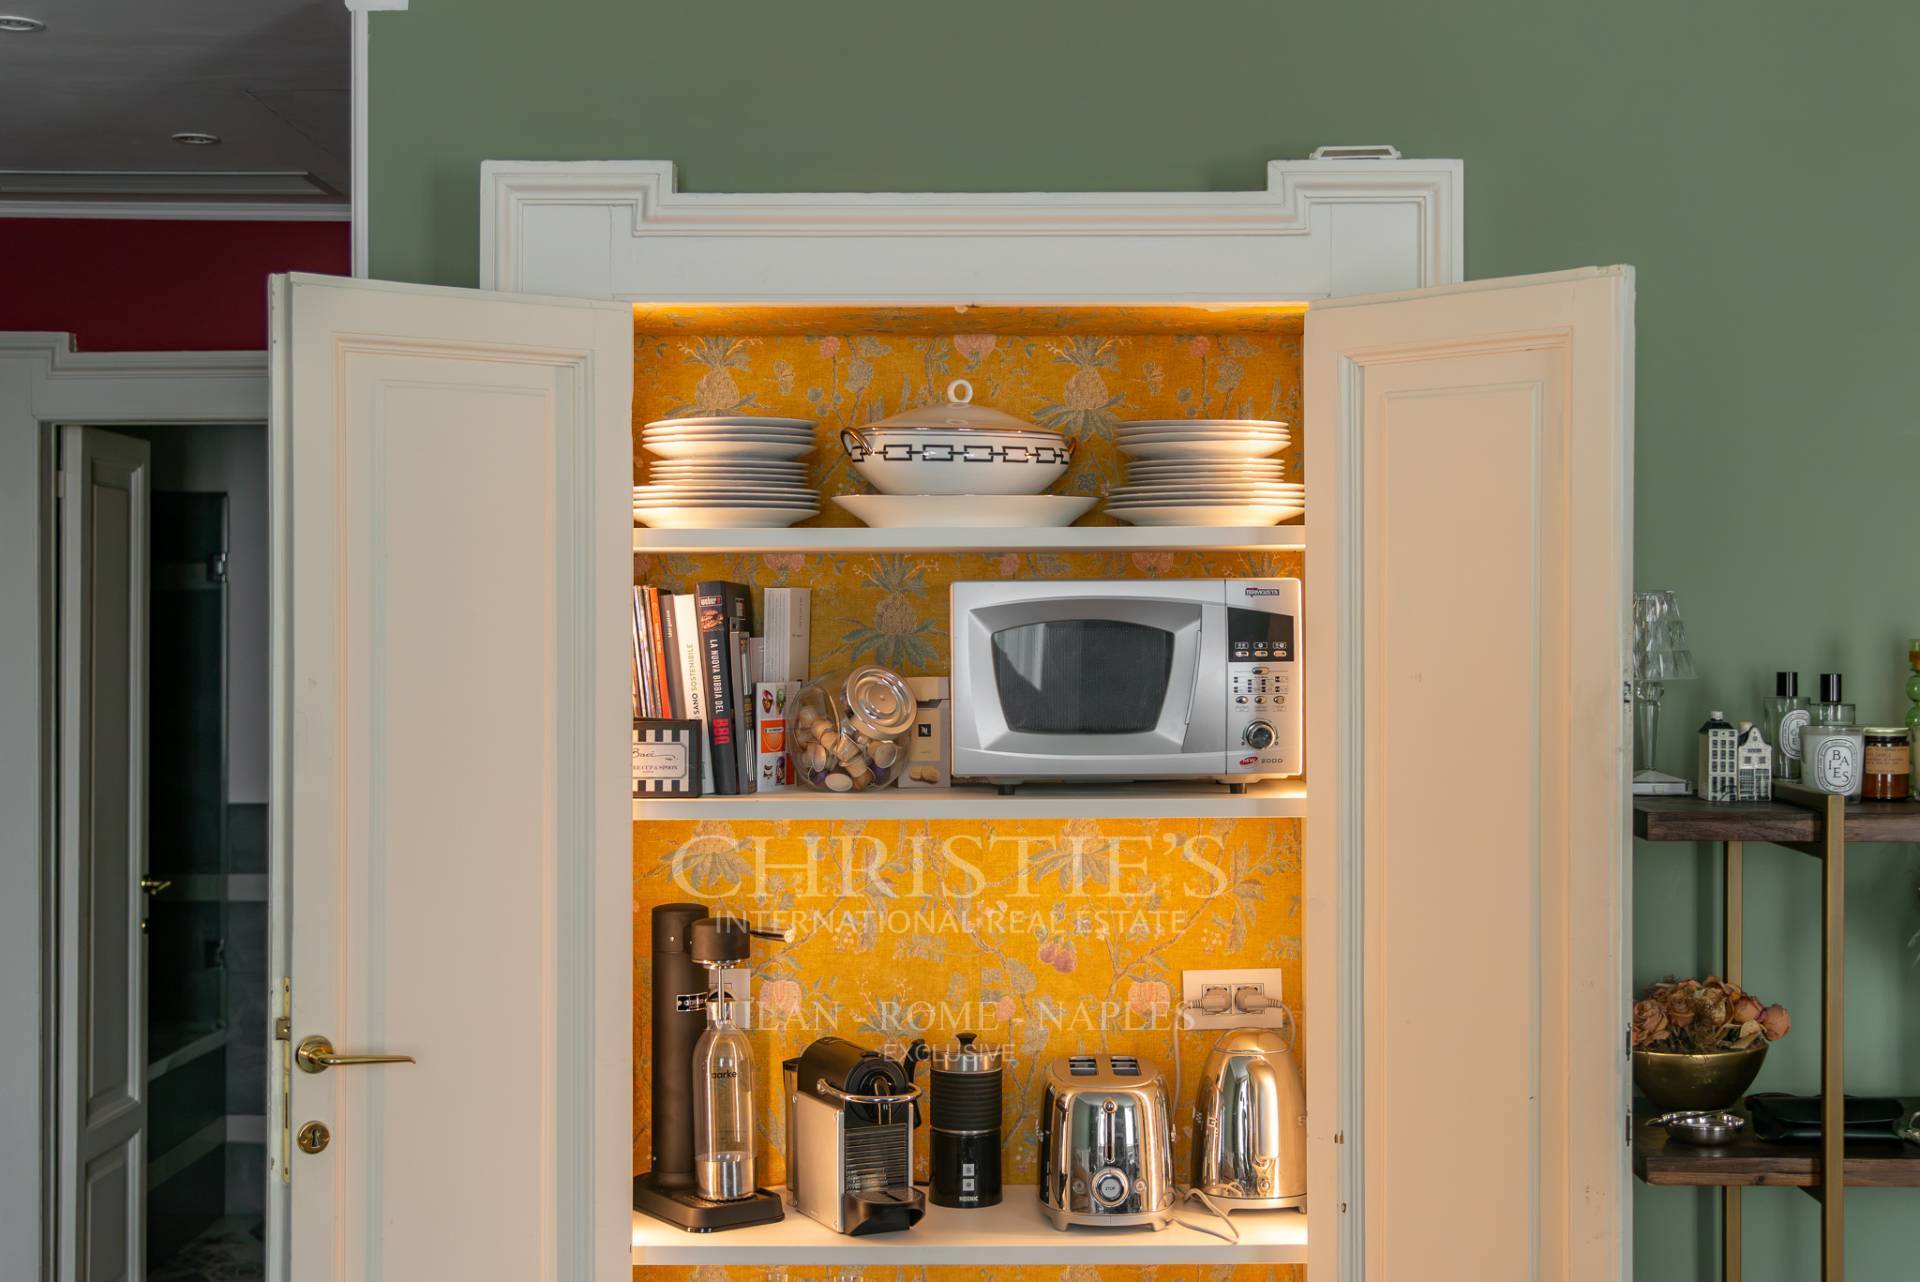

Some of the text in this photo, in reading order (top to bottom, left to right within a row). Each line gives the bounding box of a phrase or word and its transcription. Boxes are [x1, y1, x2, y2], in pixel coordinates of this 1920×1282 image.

[709, 639, 719, 649] LA
[711, 650, 721, 673] NUOVA
[712, 675, 724, 700] BIBBIA
[691, 693, 701, 717] SANO
[714, 700, 725, 715] DEL
